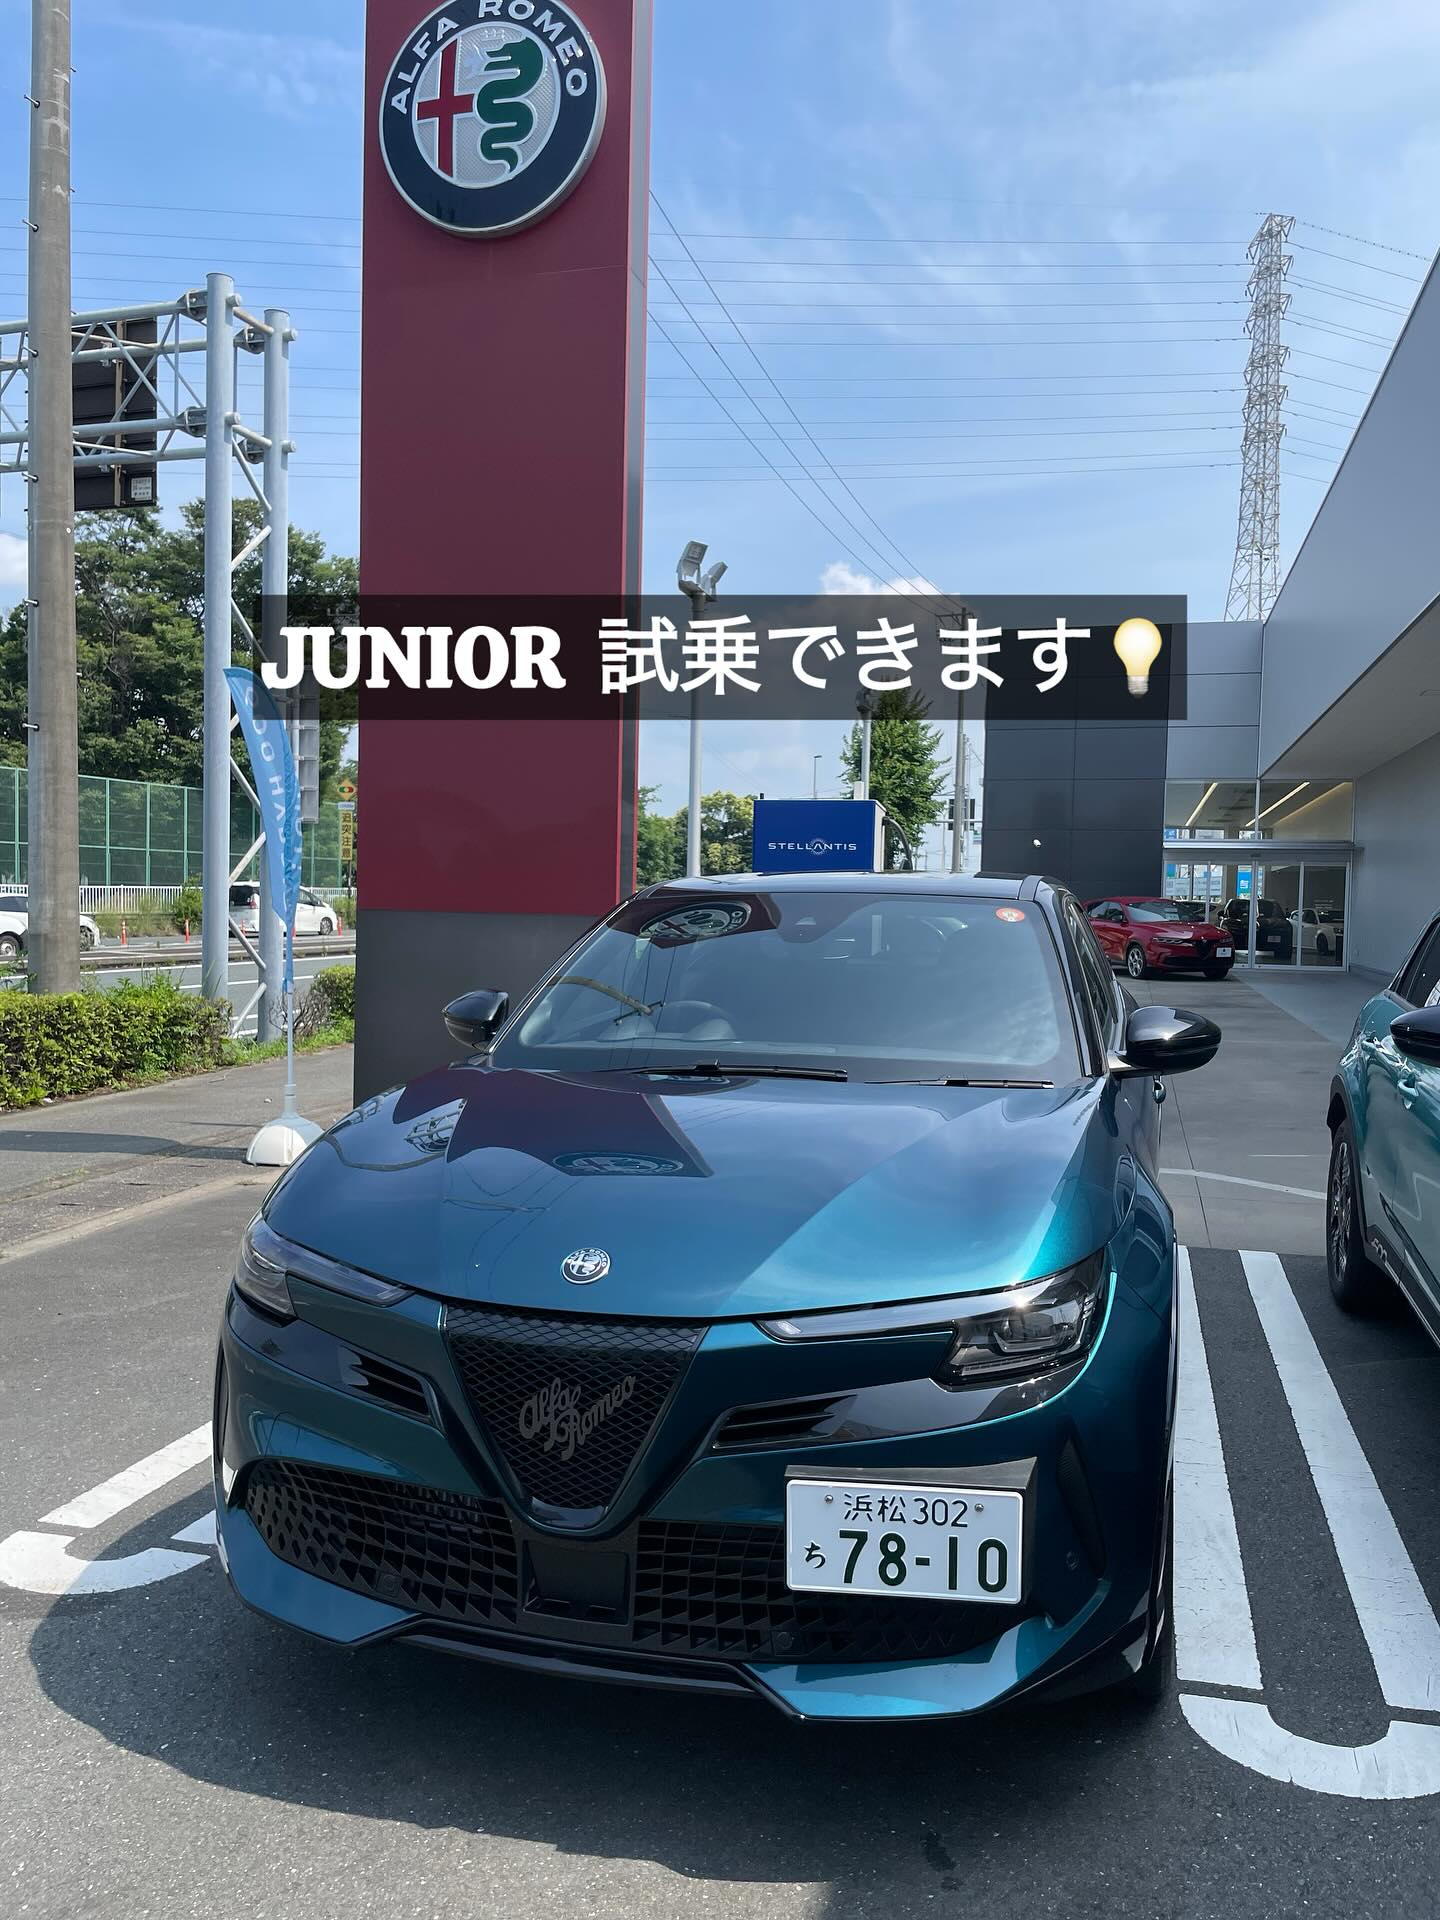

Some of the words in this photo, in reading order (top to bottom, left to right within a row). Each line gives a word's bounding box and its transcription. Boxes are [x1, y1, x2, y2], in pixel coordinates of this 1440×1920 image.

[391, 17, 459, 115] ALFA
[478, 0, 588, 97] ROMEO
[768, 842, 857, 851] STELLANTIS
[554, 1376, 637, 1461] Romeo
[839, 1529, 1008, 1593] 78-10
